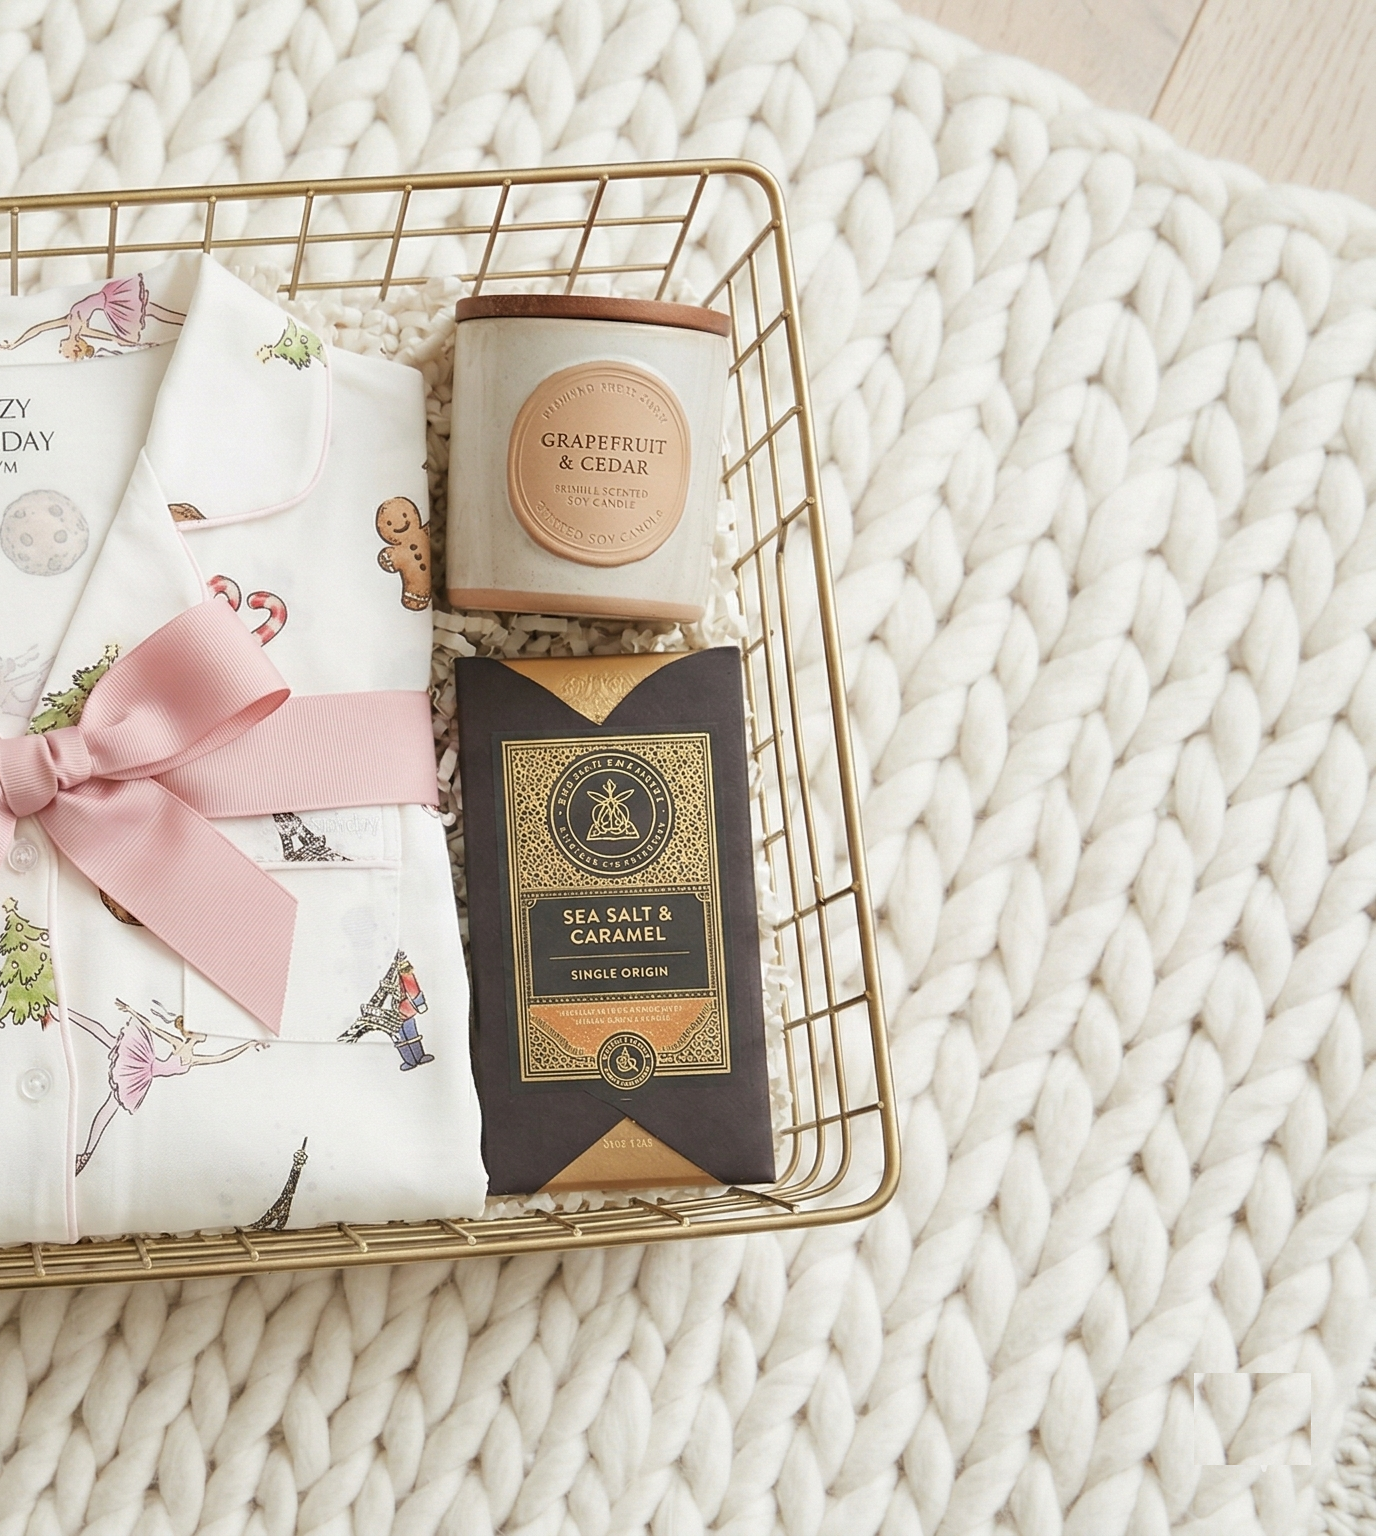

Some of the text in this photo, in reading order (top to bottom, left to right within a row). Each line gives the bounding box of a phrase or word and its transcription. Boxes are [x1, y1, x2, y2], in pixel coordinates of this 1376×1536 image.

[541, 432, 667, 455] GRAPEFRUIT
[558, 454, 649, 475] & CEDAR
[602, 487, 649, 499] SCENTED
[567, 495, 636, 510] SOY CANDLE
[588, 534, 615, 545] SOY
[563, 905, 673, 926] SEA SALT &
[570, 926, 667, 945] CARAMEL
[570, 966, 669, 981] SINGLE ORIGIN
